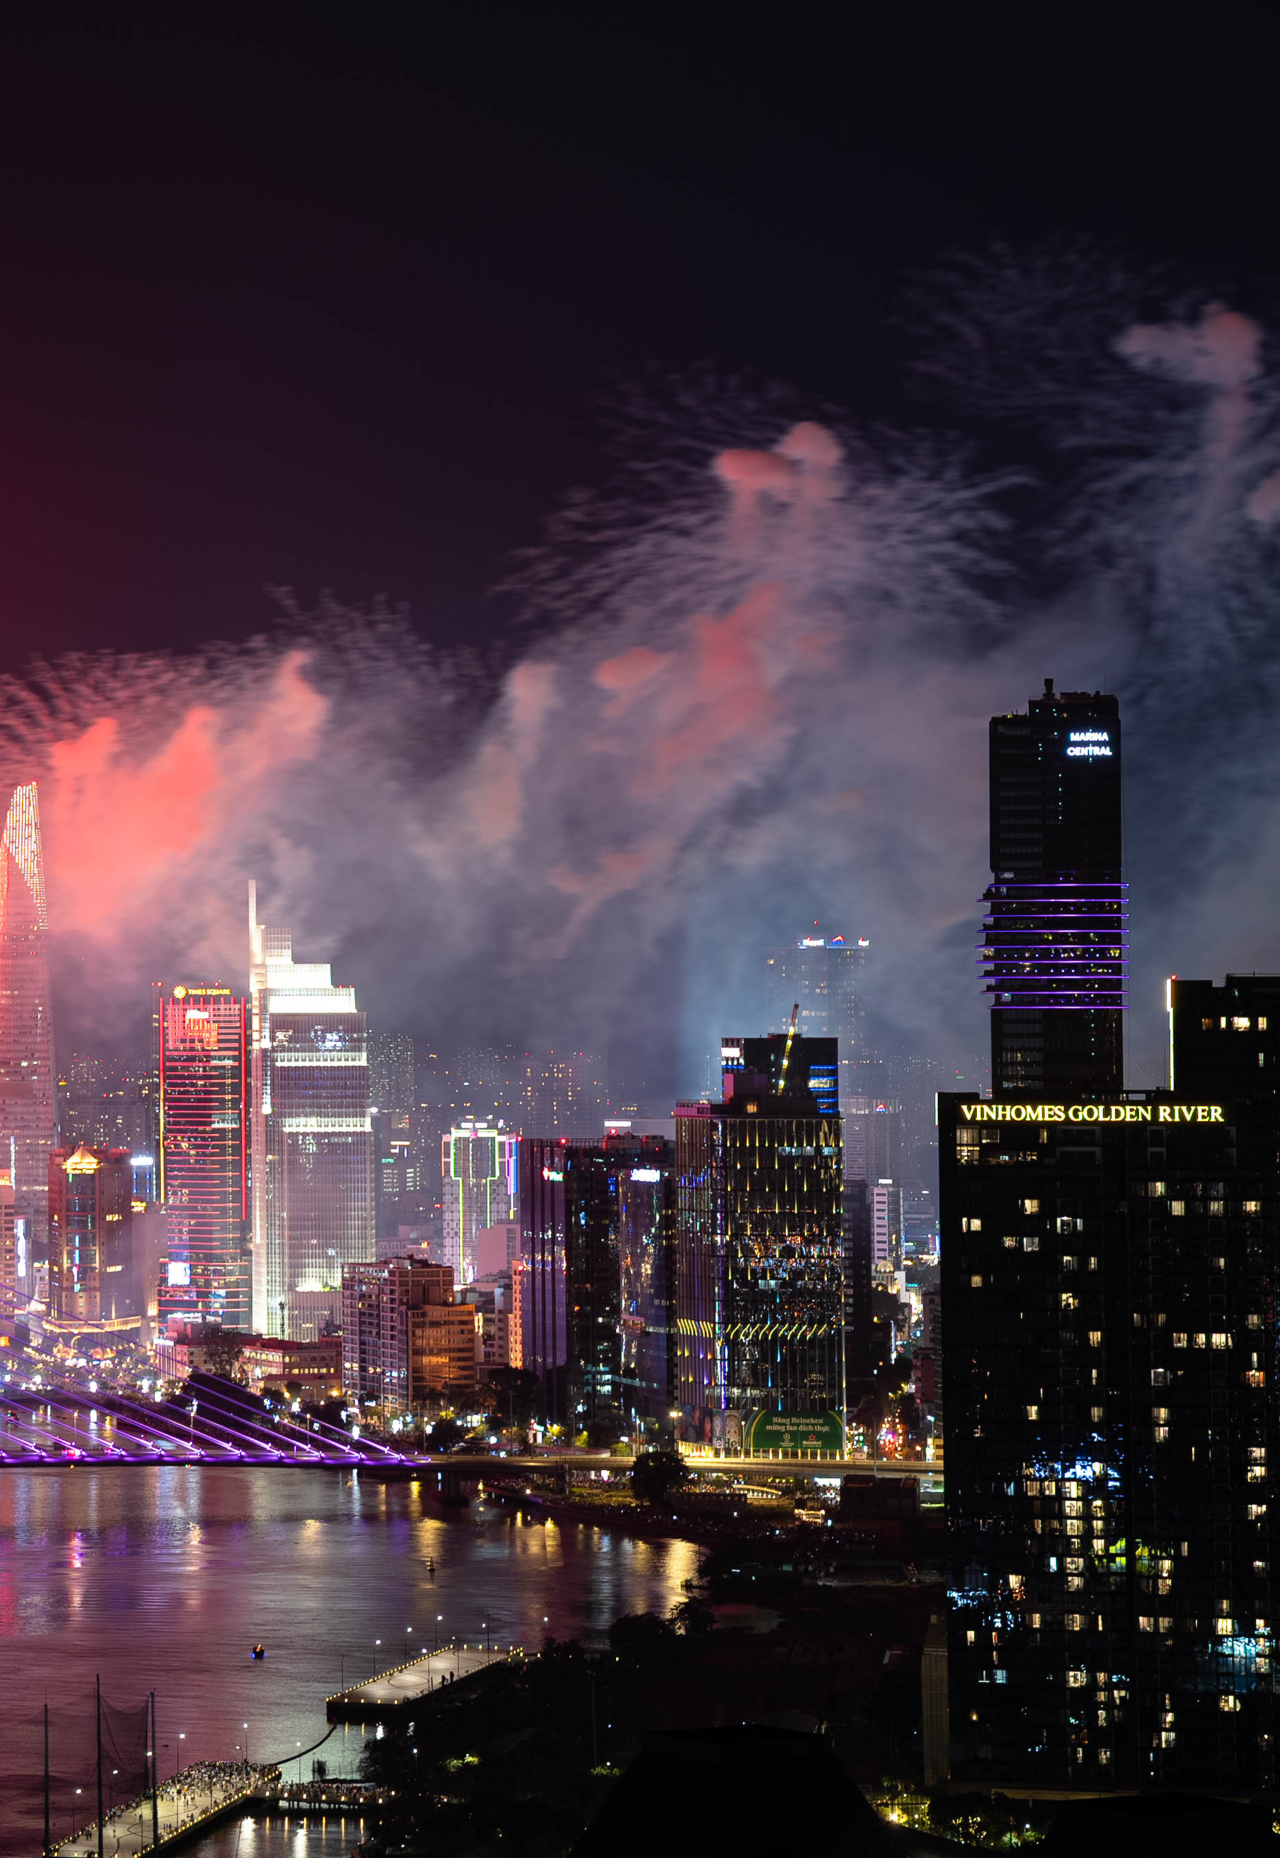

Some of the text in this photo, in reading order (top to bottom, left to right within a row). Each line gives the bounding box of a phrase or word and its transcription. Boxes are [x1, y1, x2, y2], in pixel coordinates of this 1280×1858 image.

[1070, 732, 1109, 741] MARINA
[1067, 746, 1112, 756] CENTRAL
[206, 988, 231, 996] SQUARE
[961, 1105, 1225, 1122] VINHOMES GOLDEN RIVER
